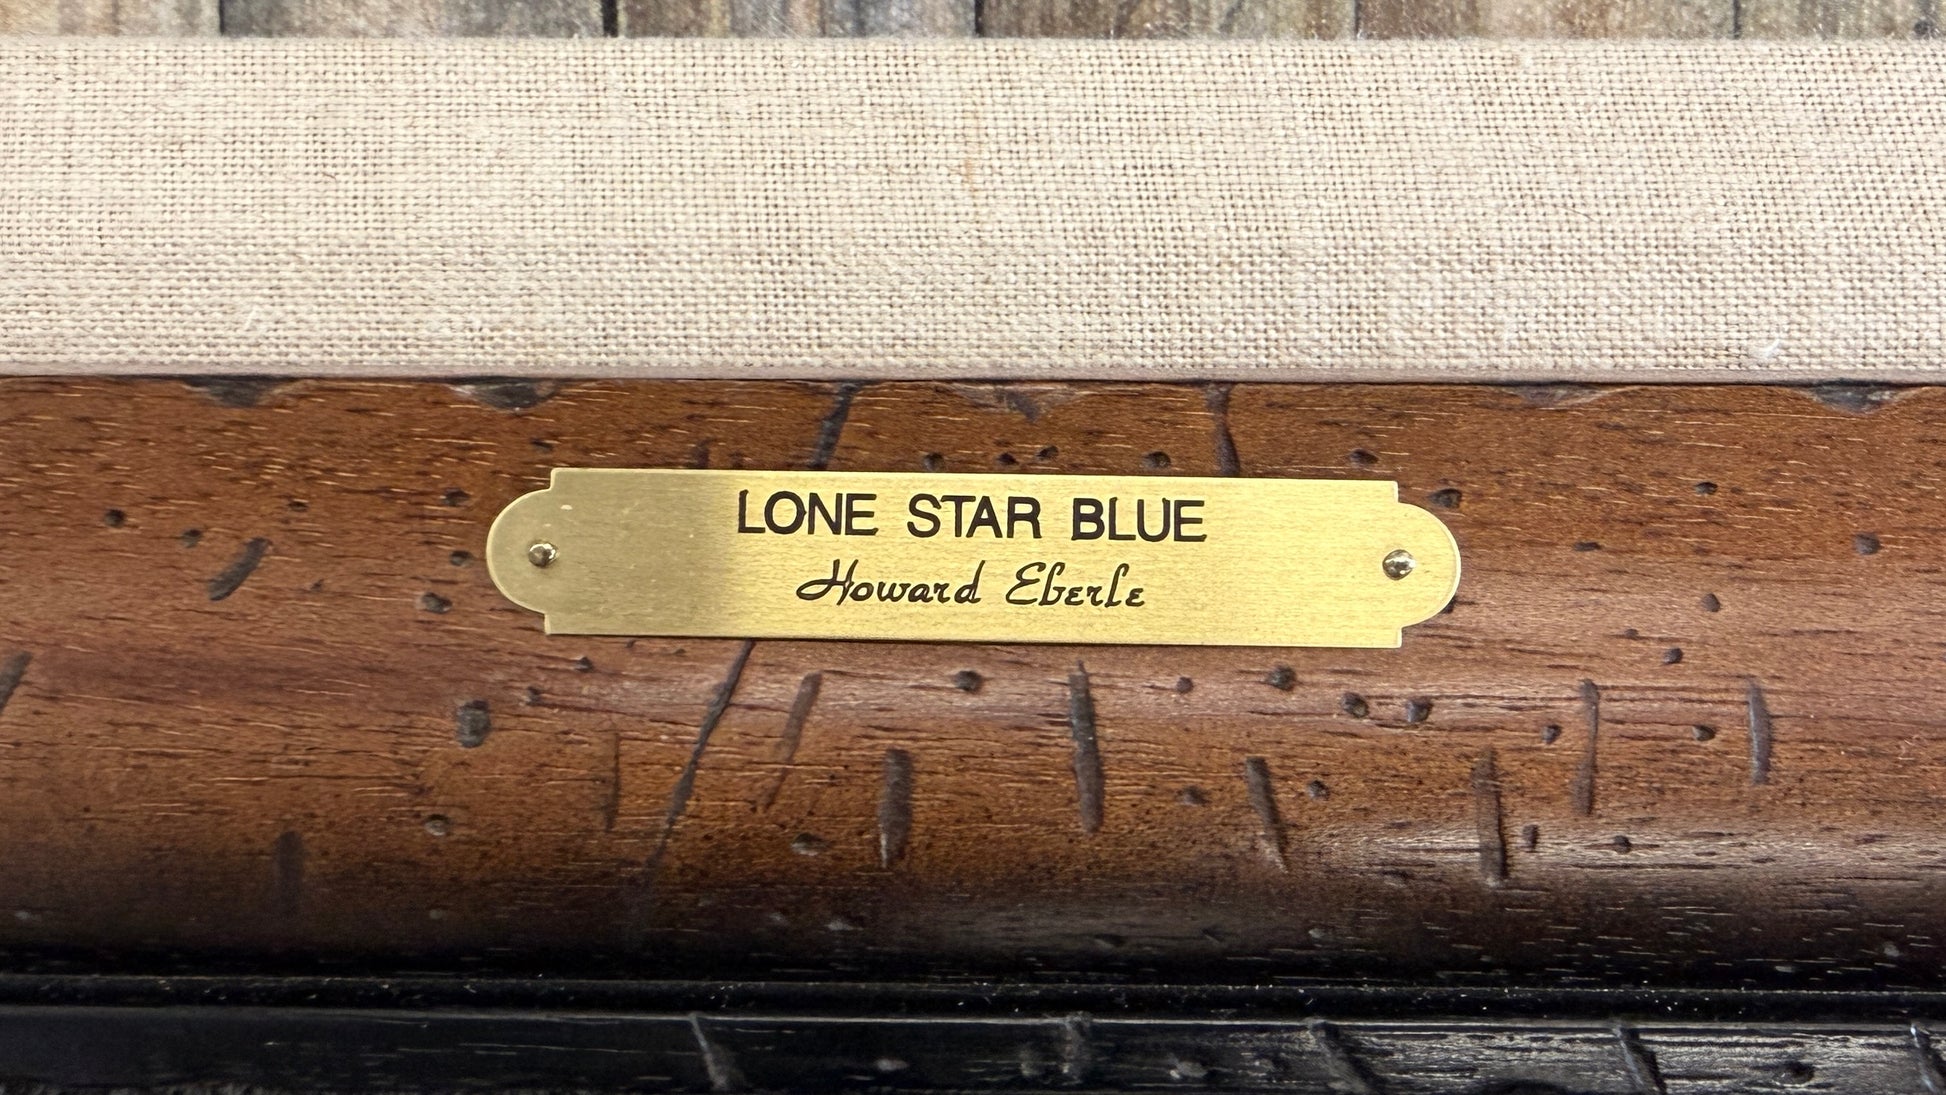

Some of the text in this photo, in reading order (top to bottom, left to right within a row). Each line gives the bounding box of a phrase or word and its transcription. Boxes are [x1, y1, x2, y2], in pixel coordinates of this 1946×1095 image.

[738, 489, 1207, 543] LONE STAR BLUE
[796, 559, 1145, 608] Howard Eberle
